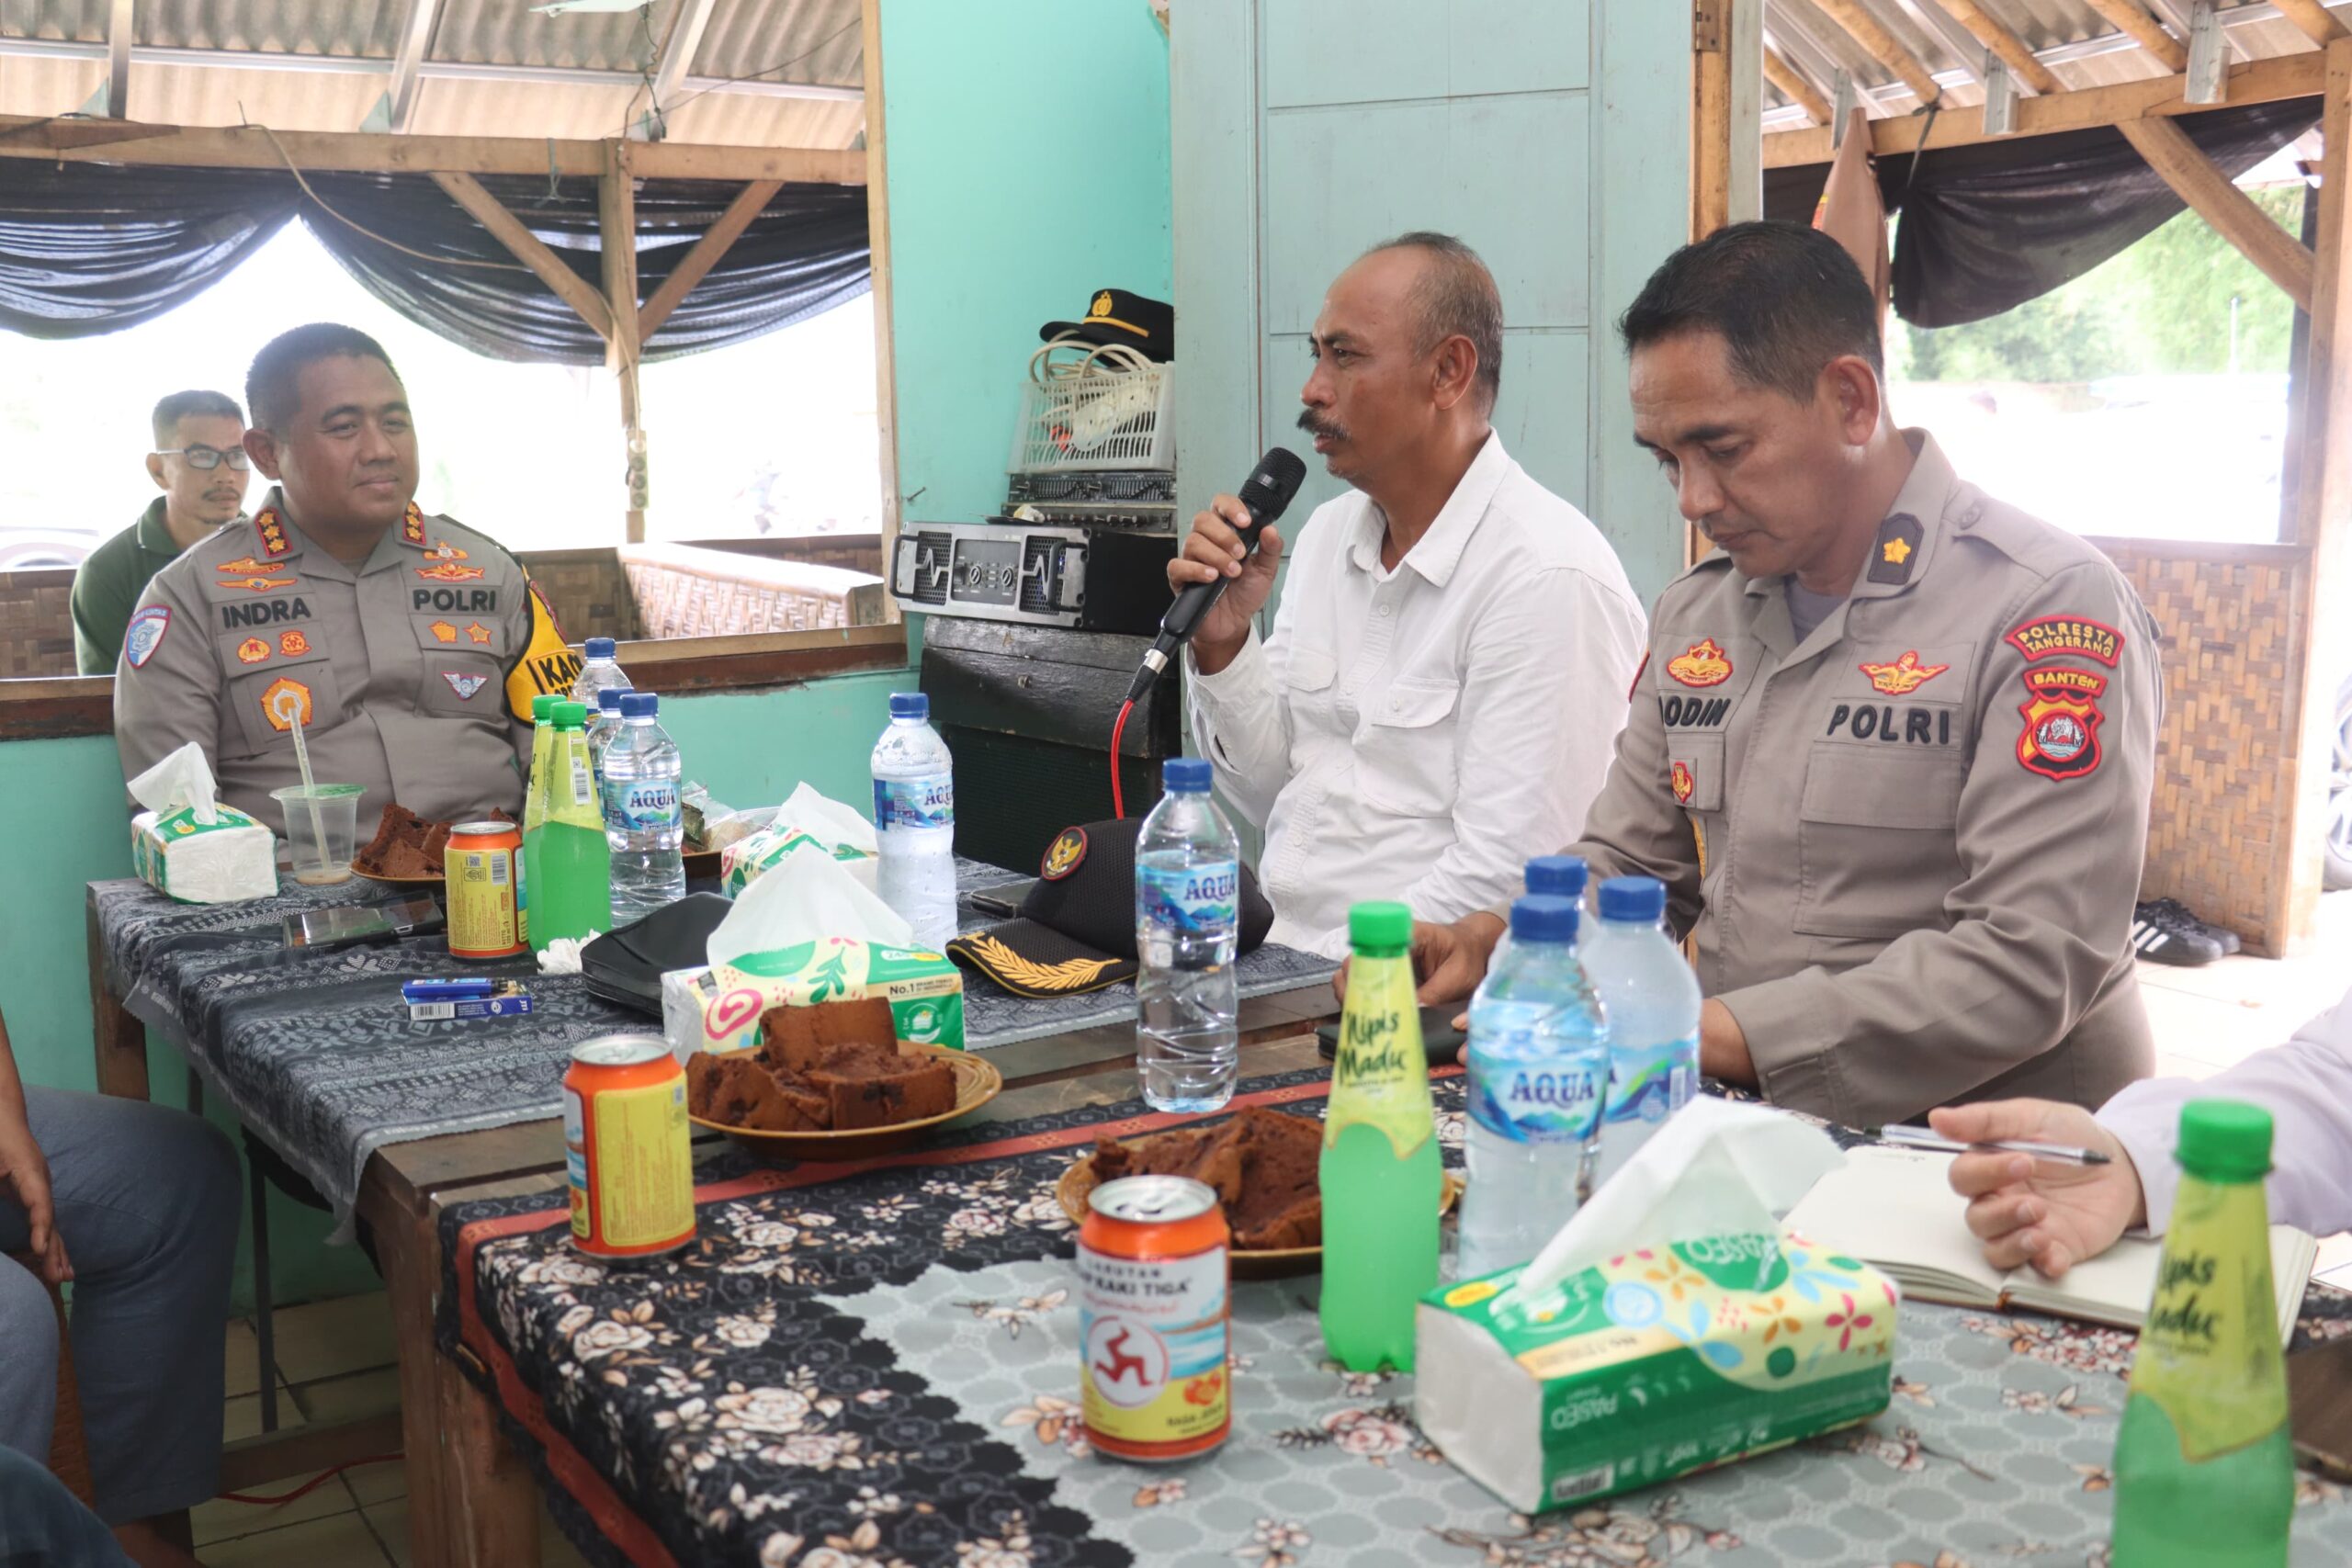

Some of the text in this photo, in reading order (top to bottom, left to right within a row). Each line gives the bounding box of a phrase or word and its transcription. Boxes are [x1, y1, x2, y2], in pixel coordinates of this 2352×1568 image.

[221, 597, 311, 629] INDRA
[413, 589, 497, 612] POLRI
[2017, 622, 2114, 649] POLRESTA
[2025, 636, 2113, 658] TANGERANG
[2033, 671, 2099, 689] BANTEN
[1826, 704, 1950, 745] POLRI
[629, 788, 676, 810] AQUA
[1345, 1010, 1399, 1045] Nipis
[1339, 1042, 1407, 1088] Madu
[1510, 1071, 1595, 1109] AQUA
